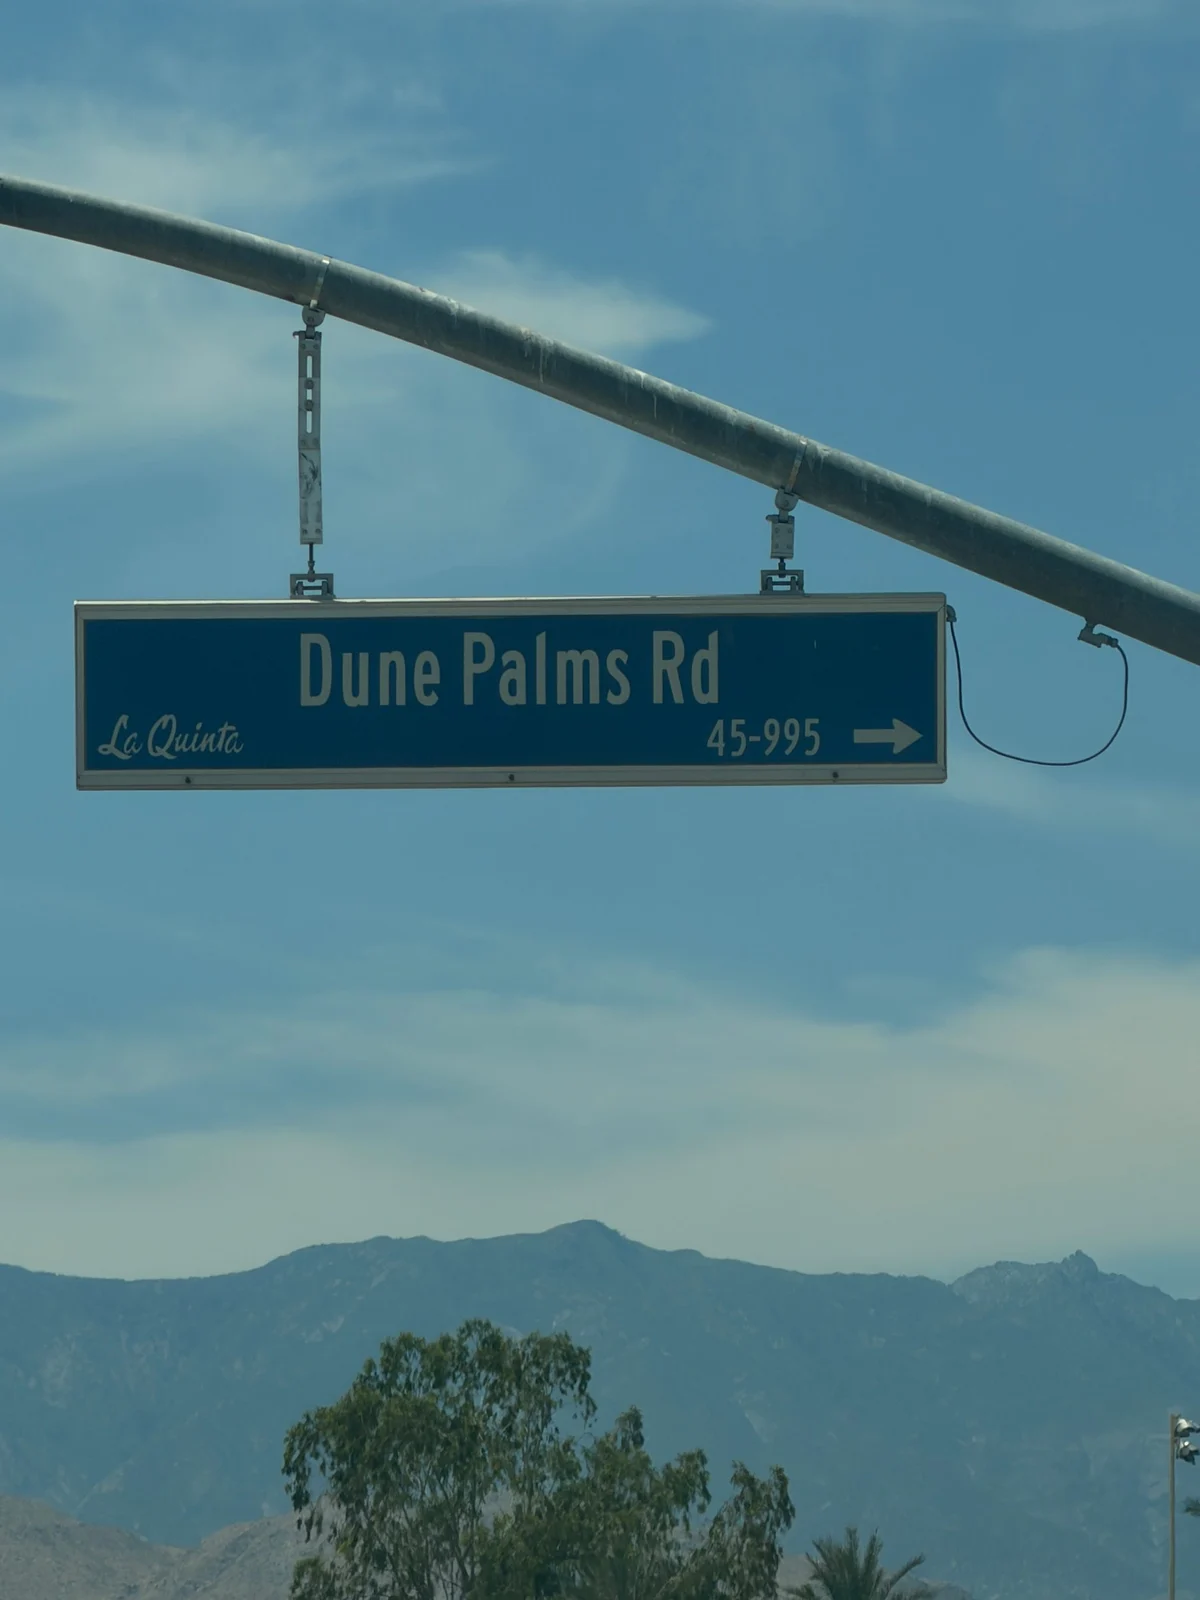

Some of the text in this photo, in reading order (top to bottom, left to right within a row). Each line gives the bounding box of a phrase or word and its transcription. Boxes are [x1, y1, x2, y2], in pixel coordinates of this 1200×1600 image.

[300, 629, 720, 707] Dune Palms Rd
[98, 713, 244, 761] La Quinta
[706, 717, 821, 758] 45-995
